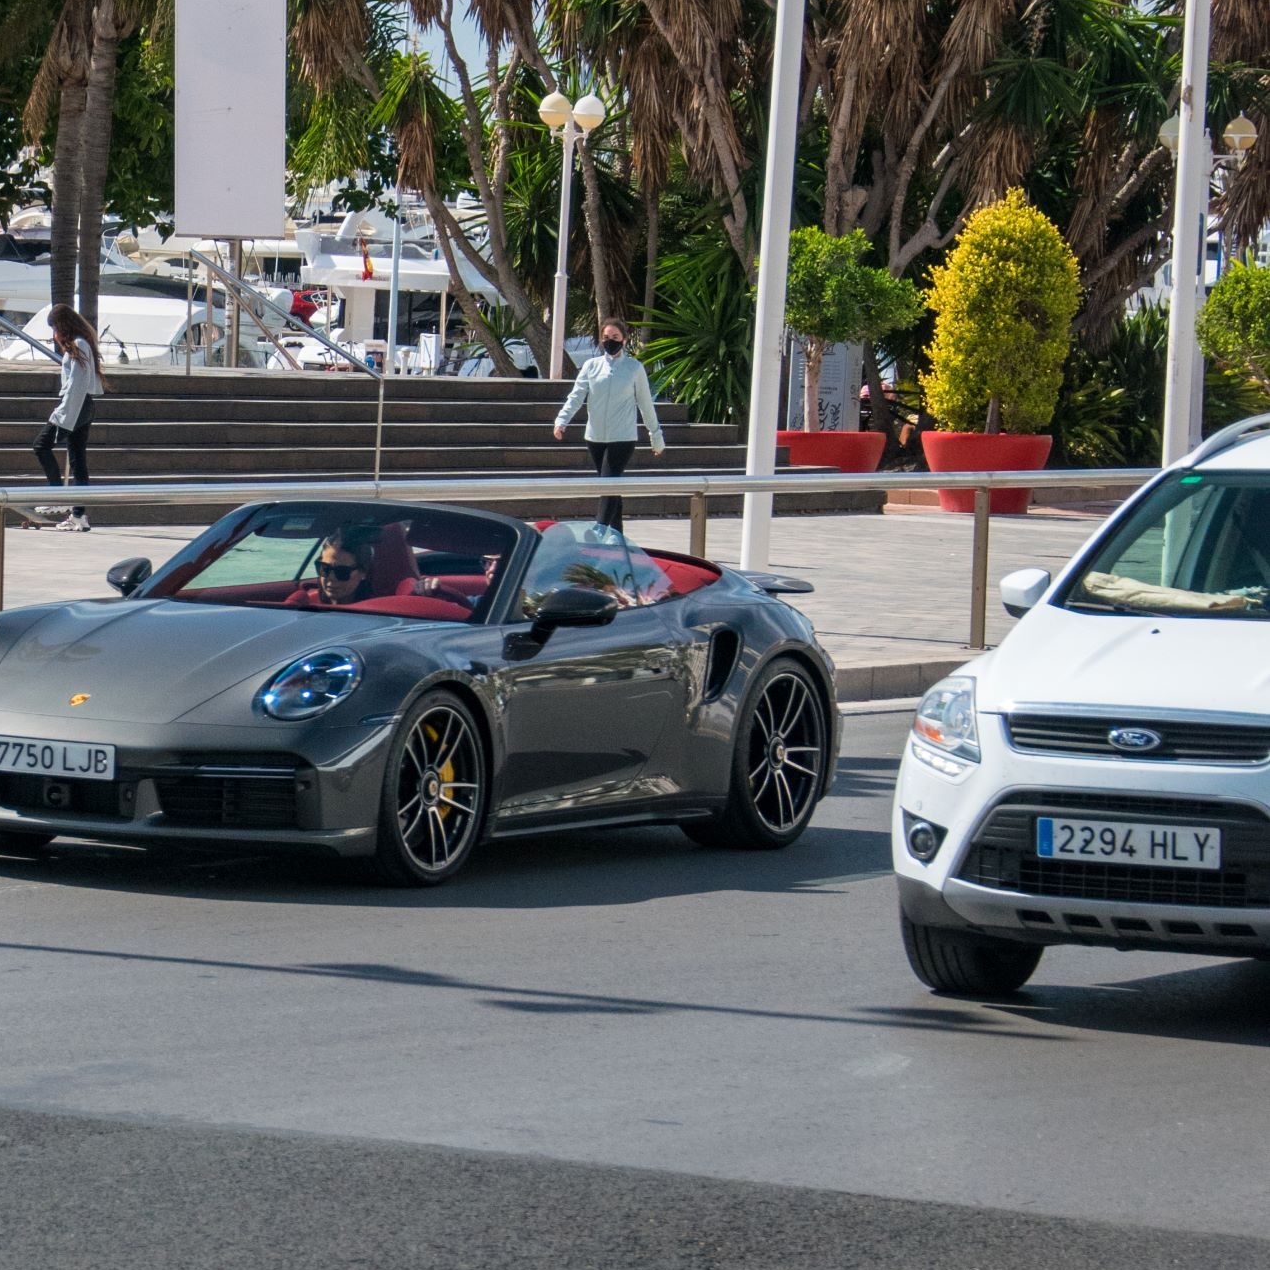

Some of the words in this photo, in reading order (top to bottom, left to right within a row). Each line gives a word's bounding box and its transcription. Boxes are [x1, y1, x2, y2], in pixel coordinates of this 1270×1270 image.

[62, 746, 108, 774] LJB
[1059, 824, 1137, 857] 2294
[1150, 830, 1210, 862] HLY
